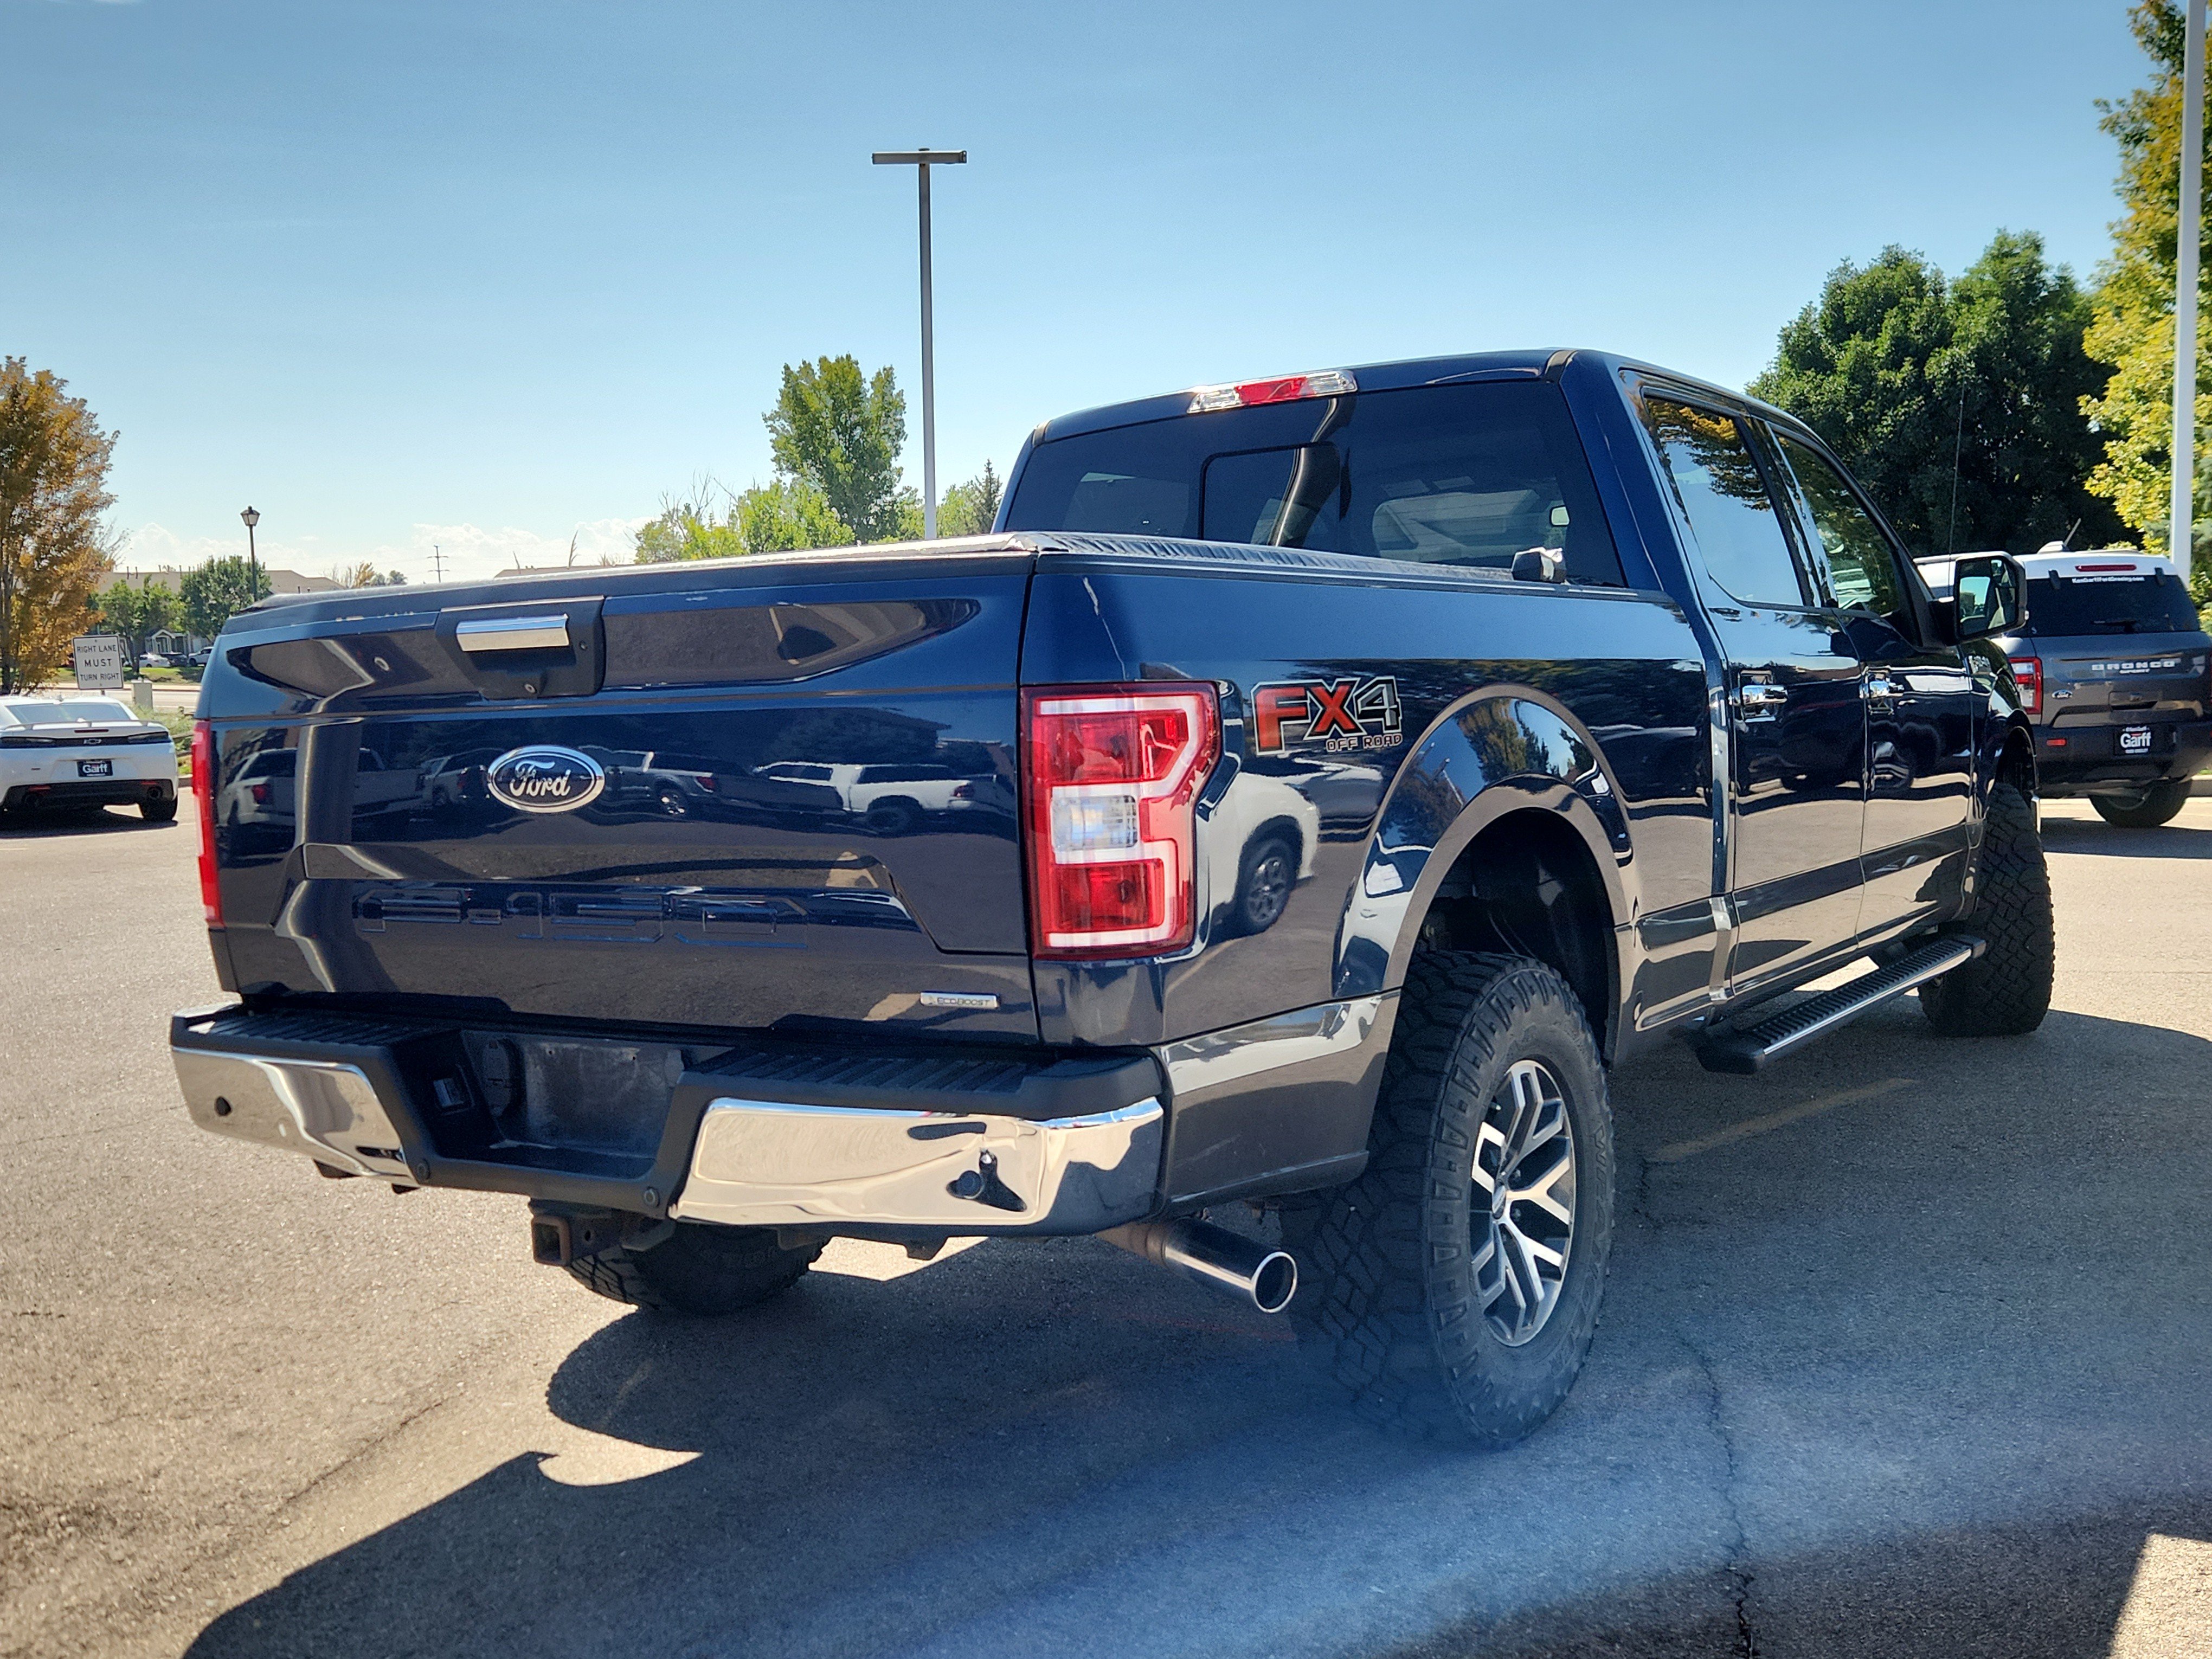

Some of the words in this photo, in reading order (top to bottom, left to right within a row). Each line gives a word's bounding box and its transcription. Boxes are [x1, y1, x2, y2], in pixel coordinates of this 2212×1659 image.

[84, 658, 112, 667] MUST
[1251, 676, 1403, 756] FX4
[1326, 737, 1358, 752] OFF
[1362, 734, 1403, 749] ROAD
[2120, 732, 2151, 748] Garff
[510, 760, 572, 797] Ford
